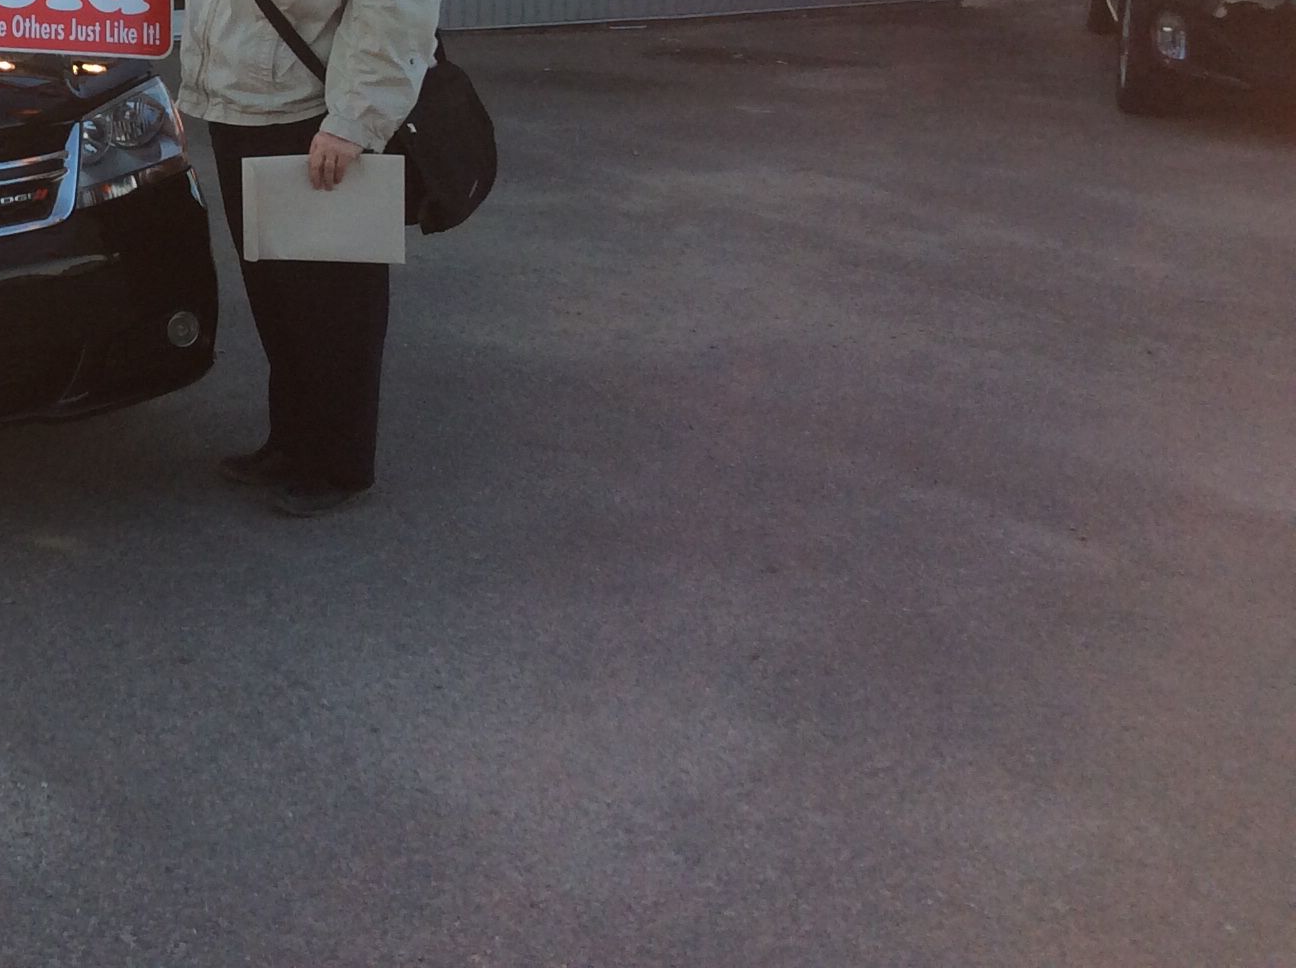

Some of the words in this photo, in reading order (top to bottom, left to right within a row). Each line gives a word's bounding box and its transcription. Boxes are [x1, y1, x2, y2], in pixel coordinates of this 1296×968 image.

[11, 14, 65, 41] Others
[69, 17, 101, 43] Just
[105, 19, 138, 45] Like
[142, 22, 161, 46] It!
